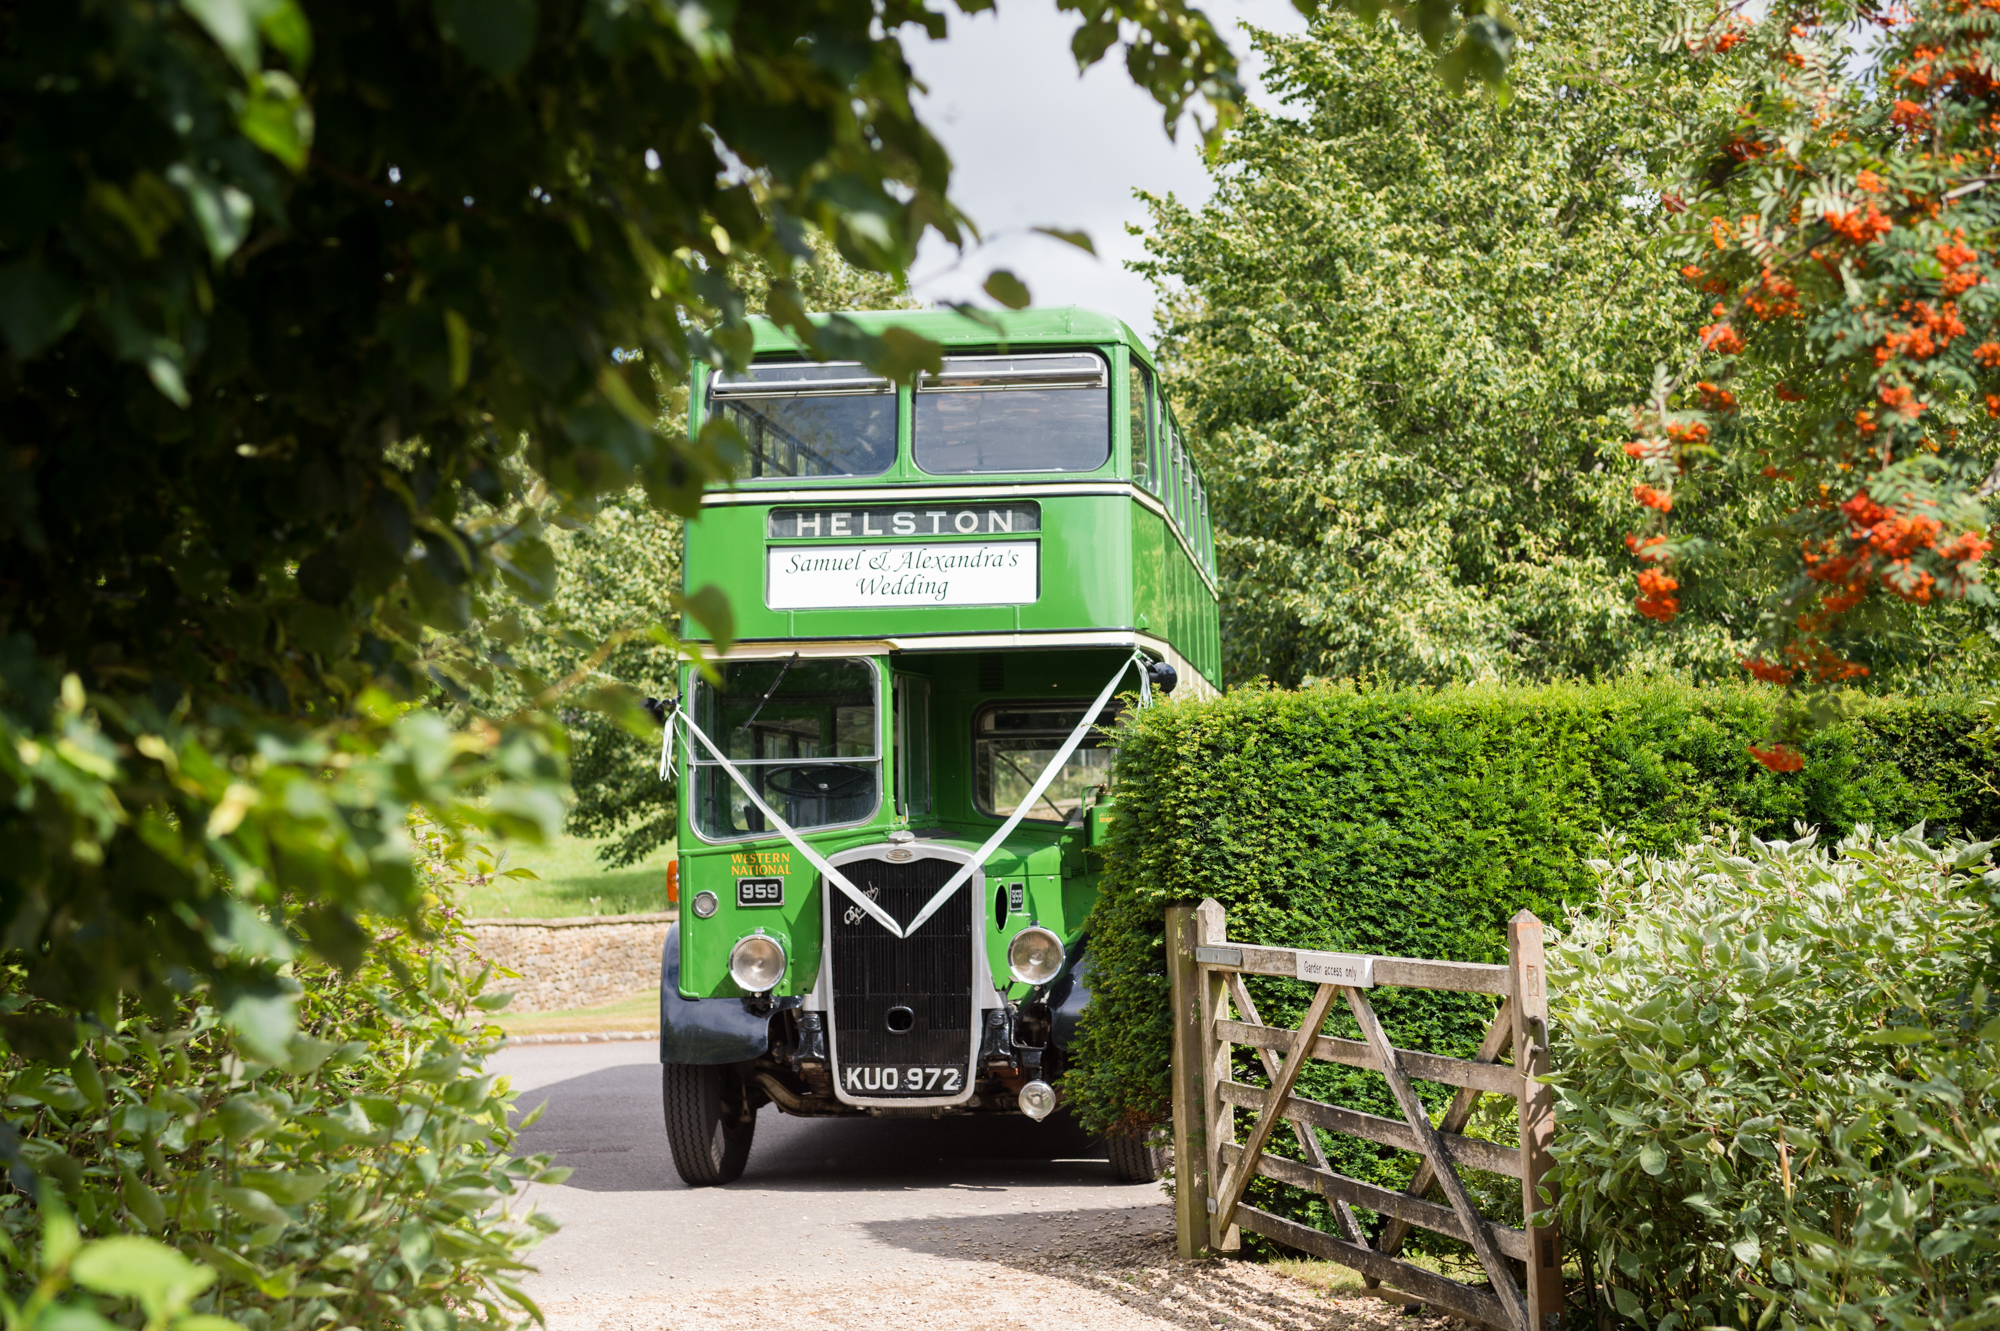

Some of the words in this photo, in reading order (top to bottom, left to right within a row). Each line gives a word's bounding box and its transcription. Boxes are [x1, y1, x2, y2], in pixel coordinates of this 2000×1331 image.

[796, 510, 1013, 536] HELSTON
[786, 550, 865, 574] Samuel
[869, 549, 891, 570] &
[893, 547, 1019, 572] Alexandra's
[856, 575, 949, 601] Wedding
[731, 852, 790, 864] WESTERN
[731, 864, 792, 876] NATIONAL
[742, 884, 778, 899] 959
[1304, 961, 1322, 975] Garden
[1324, 966, 1342, 977] access
[1345, 966, 1357, 981] only
[846, 1067, 898, 1090] KUO
[907, 1067, 960, 1090] 972
